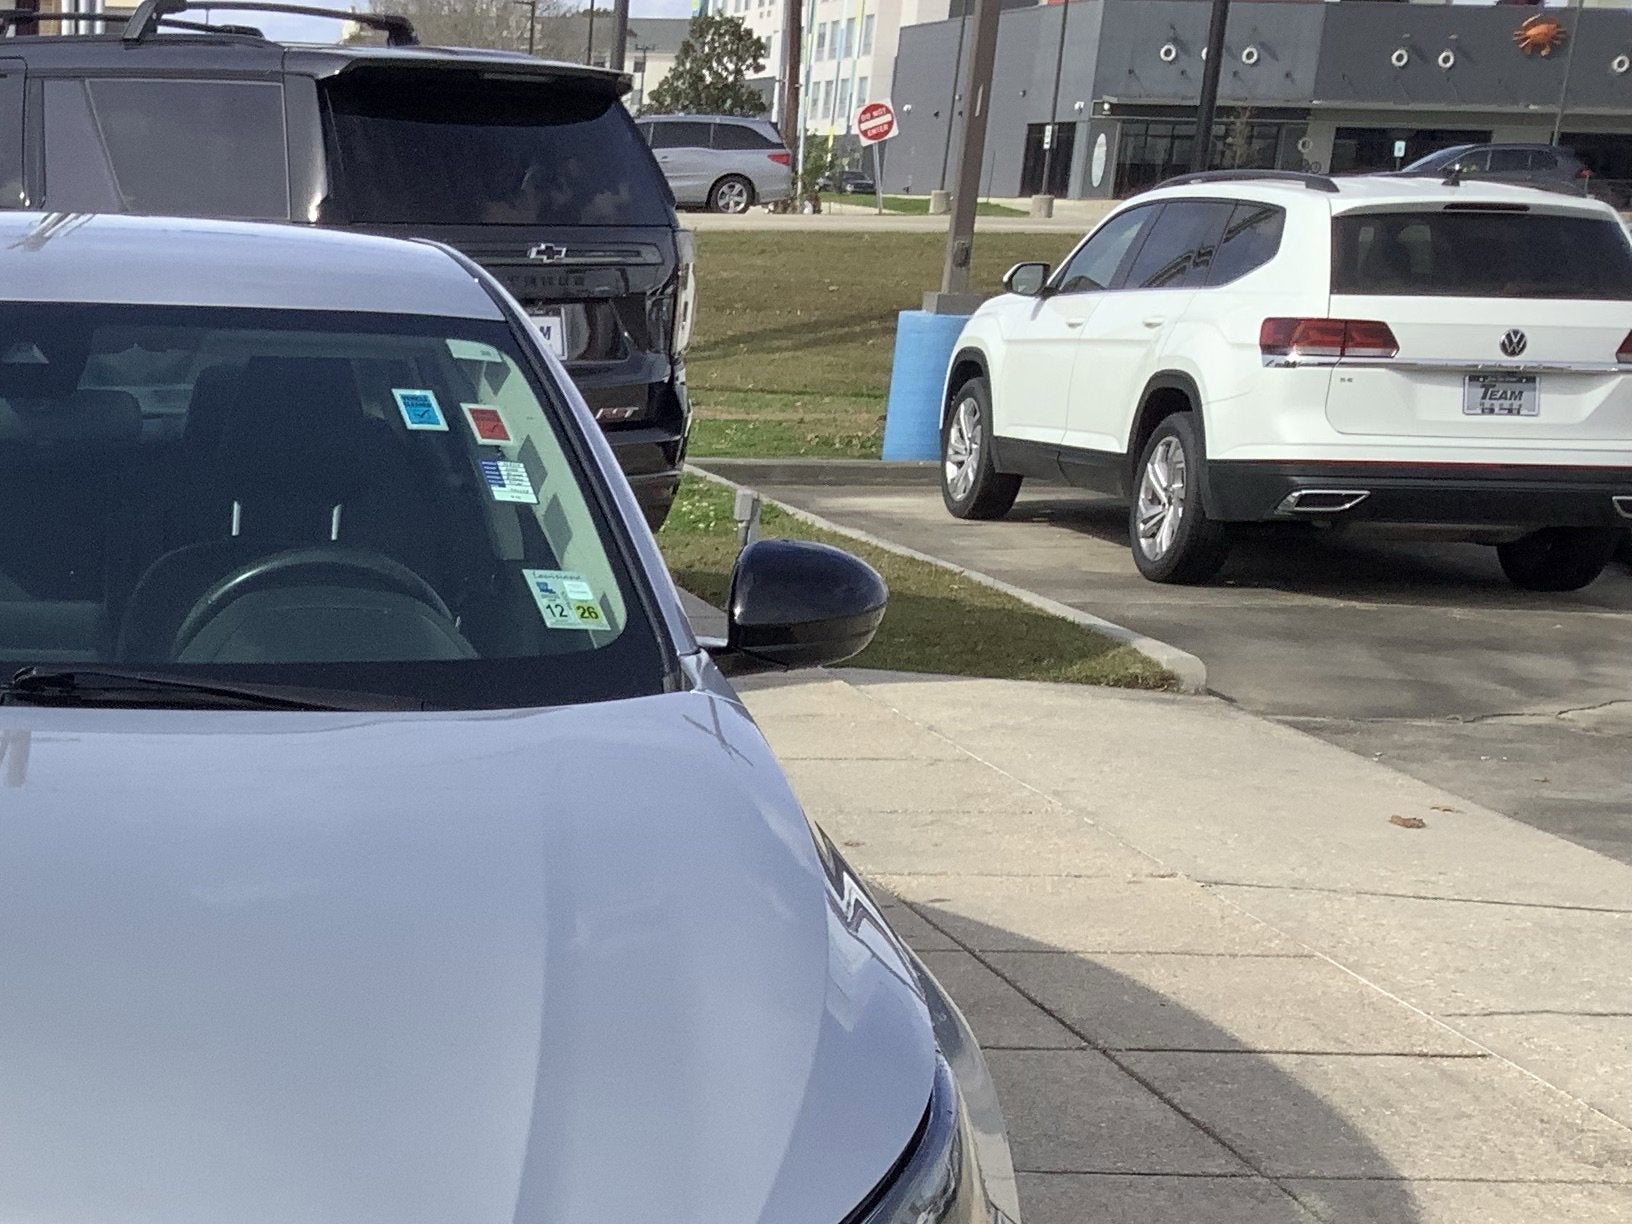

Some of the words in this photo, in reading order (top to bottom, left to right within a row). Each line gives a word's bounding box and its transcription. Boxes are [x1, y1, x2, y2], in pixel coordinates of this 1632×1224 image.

[860, 112, 872, 121] DO
[872, 107, 887, 117] NOT
[867, 123, 889, 137] ENTER
[546, 603, 569, 618] 12
[576, 605, 600, 620] 26
